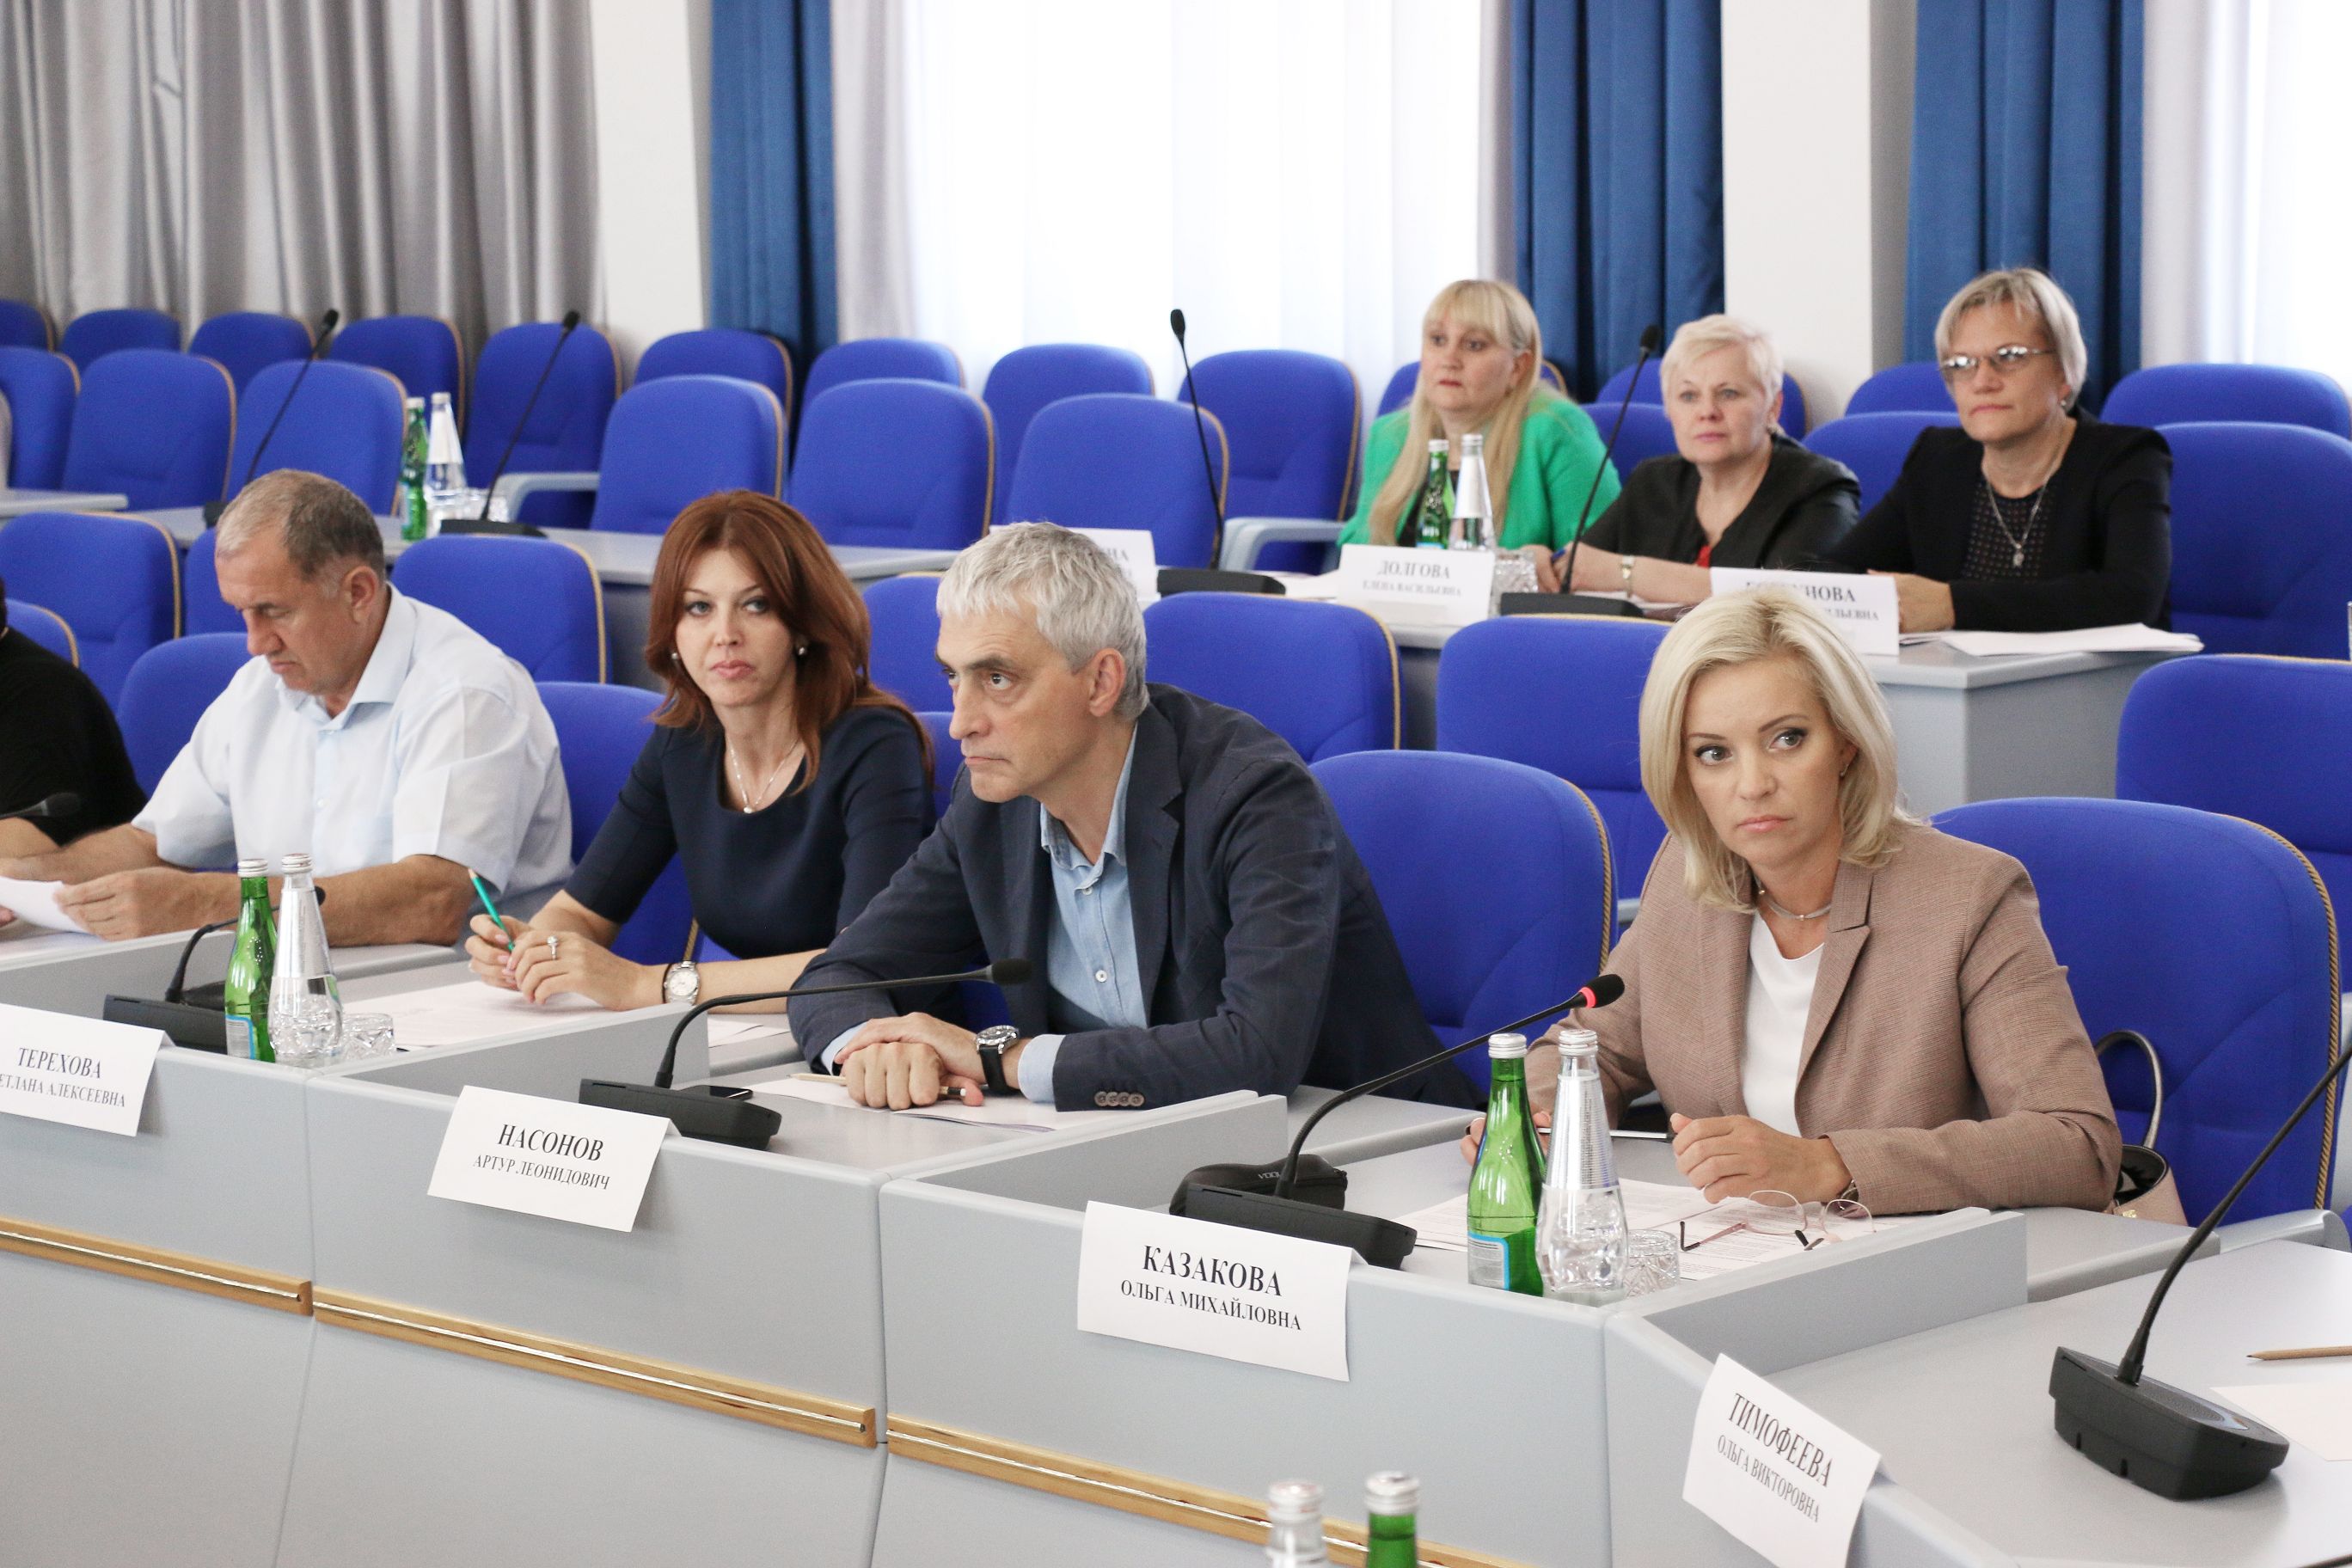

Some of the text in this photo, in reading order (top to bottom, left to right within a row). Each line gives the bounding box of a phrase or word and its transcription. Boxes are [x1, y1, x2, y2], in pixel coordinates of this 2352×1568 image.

[1377, 560, 1450, 579] ДОЛГОВА
[17, 1047, 101, 1079] ТЕРЕХОВА
[46, 1082, 126, 1107] АЛЕКСЕЕВНА
[497, 1124, 603, 1161] НАСОНОВ
[473, 1155, 610, 1190] АРТУР ЛЕОНИДОВИЧ
[1142, 1245, 1283, 1296] КАЗАКОВА
[1120, 1279, 1302, 1331] ОЛЬГА МИХАЙЛОВНА
[1728, 1393, 1834, 1488] ТИМОФЕЕВА
[1718, 1434, 1821, 1523] ОЛЬГА ВИКТОРОВНА
